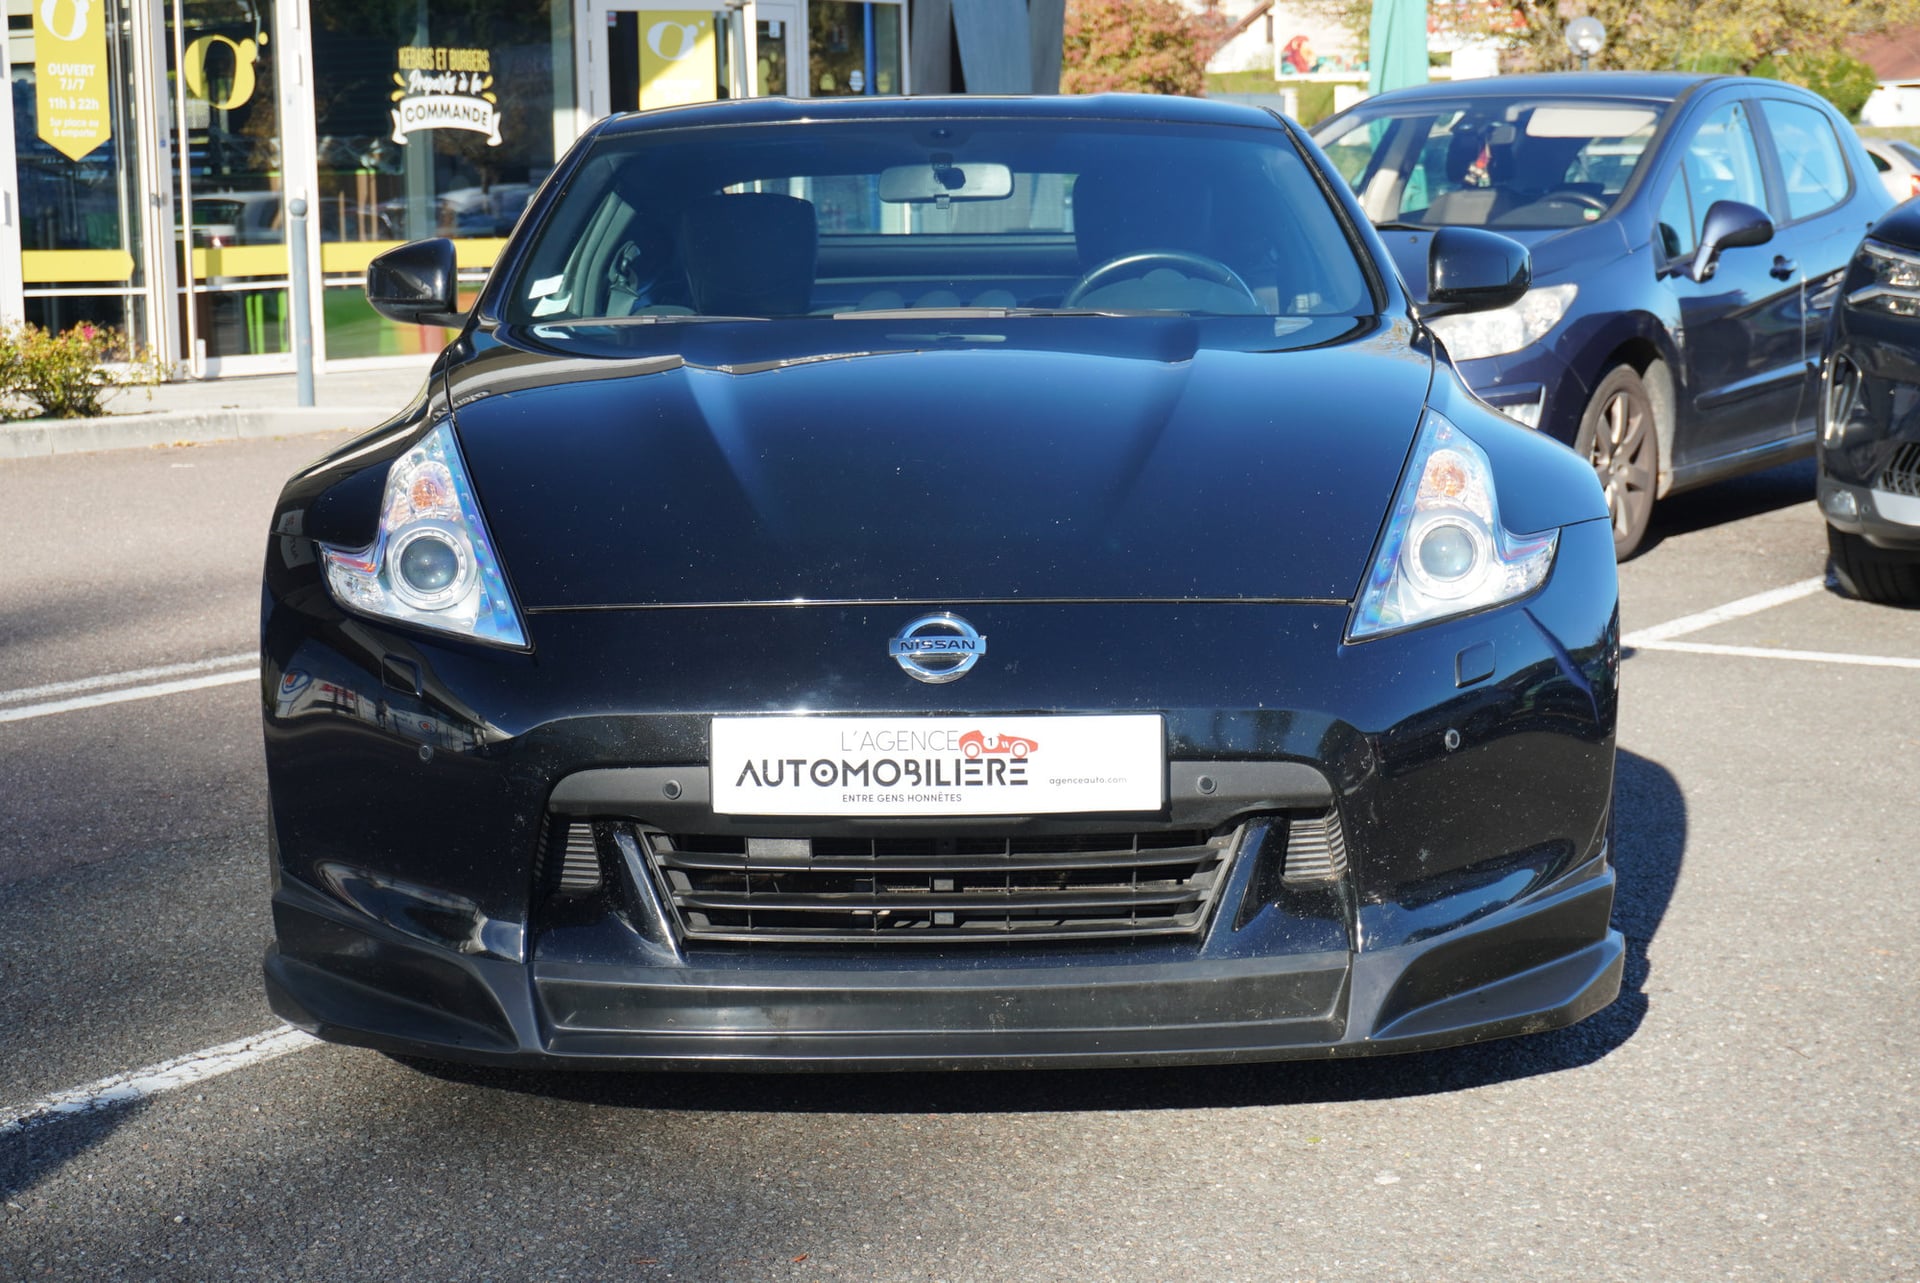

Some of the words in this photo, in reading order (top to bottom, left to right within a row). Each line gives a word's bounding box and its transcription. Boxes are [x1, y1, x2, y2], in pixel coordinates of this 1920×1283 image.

[435, 47, 448, 71] ET
[47, 63, 96, 77] OUVERT
[47, 96, 67, 110] 11h
[77, 97, 100, 111] 22h
[405, 103, 489, 127] COMMANDE
[900, 639, 976, 652] NISSAN
[841, 730, 960, 752] L'AGENCE
[735, 757, 1029, 788] AUTOMOBILIERE
[1048, 775, 1129, 787] agenceauto.com
[842, 793, 874, 803] ENTRE
[876, 793, 905, 803] GENS
[907, 790, 962, 803] HONNÊTES
